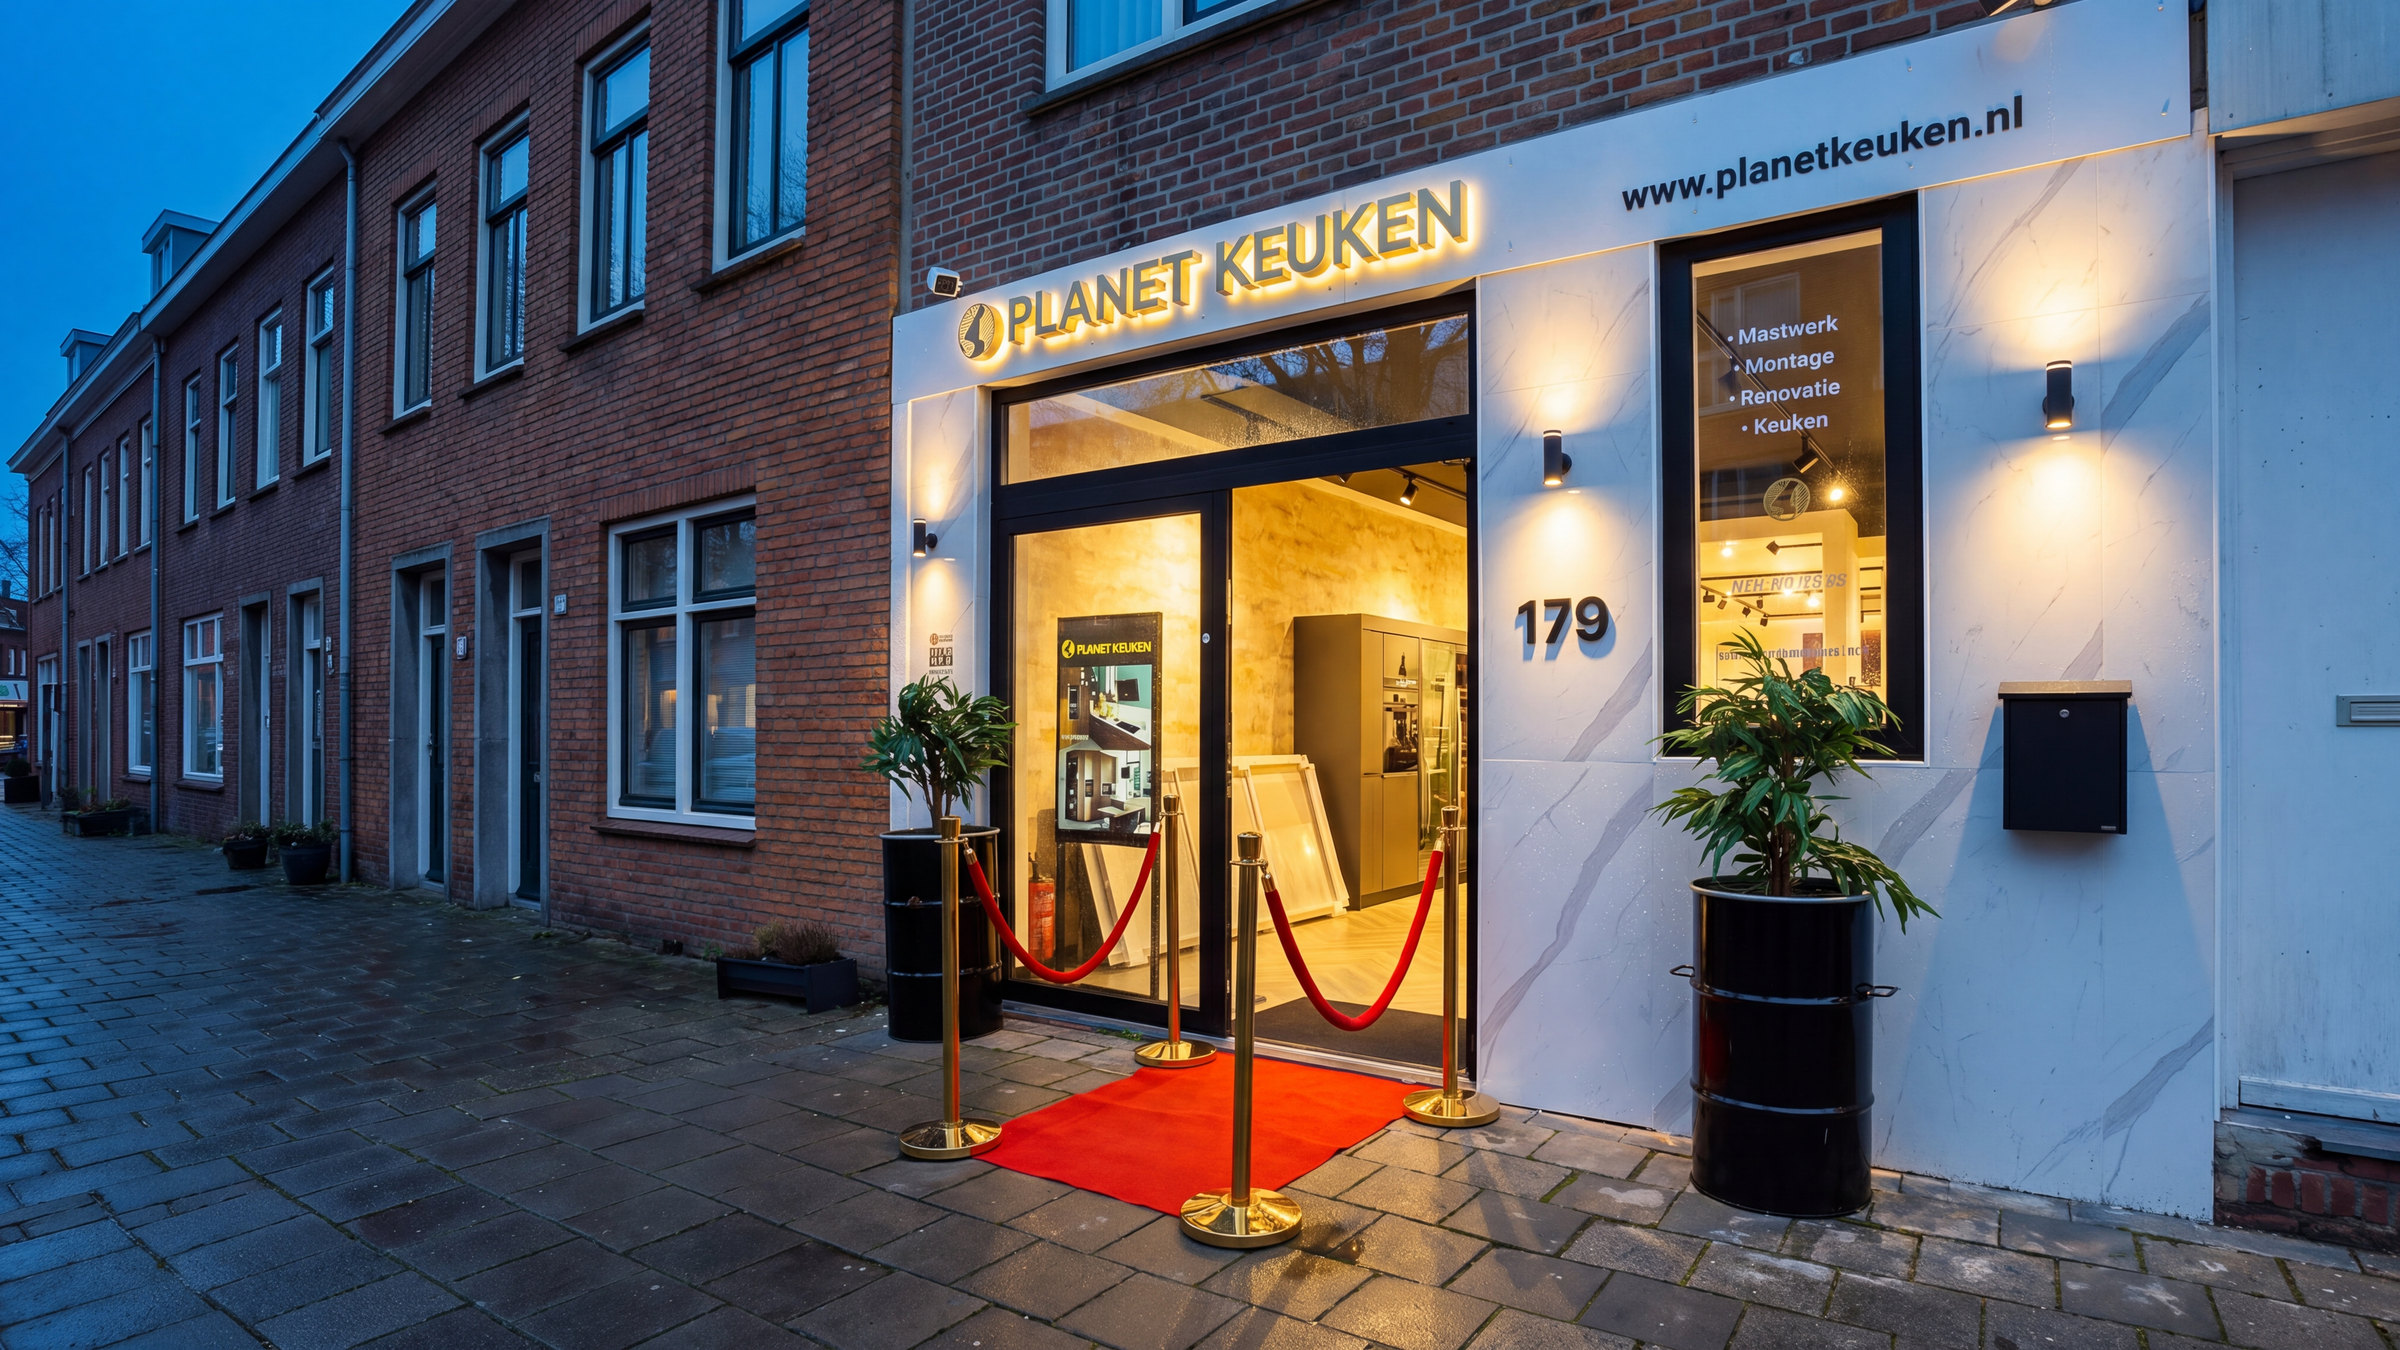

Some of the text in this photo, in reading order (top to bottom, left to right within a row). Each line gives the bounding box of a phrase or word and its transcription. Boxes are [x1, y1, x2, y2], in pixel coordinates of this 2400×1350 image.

[1621, 94, 2023, 210] www.planetkeuken.nl
[1008, 180, 1468, 346] PLANET KEUKEN
[1738, 314, 1839, 345] Mastwerk
[1745, 350, 1835, 375] Montage
[1740, 378, 1841, 406] Renovatie
[1753, 413, 1829, 435] Keuken
[1517, 595, 1609, 645] 179
[1076, 641, 1152, 656] PLANET KEUKEN
